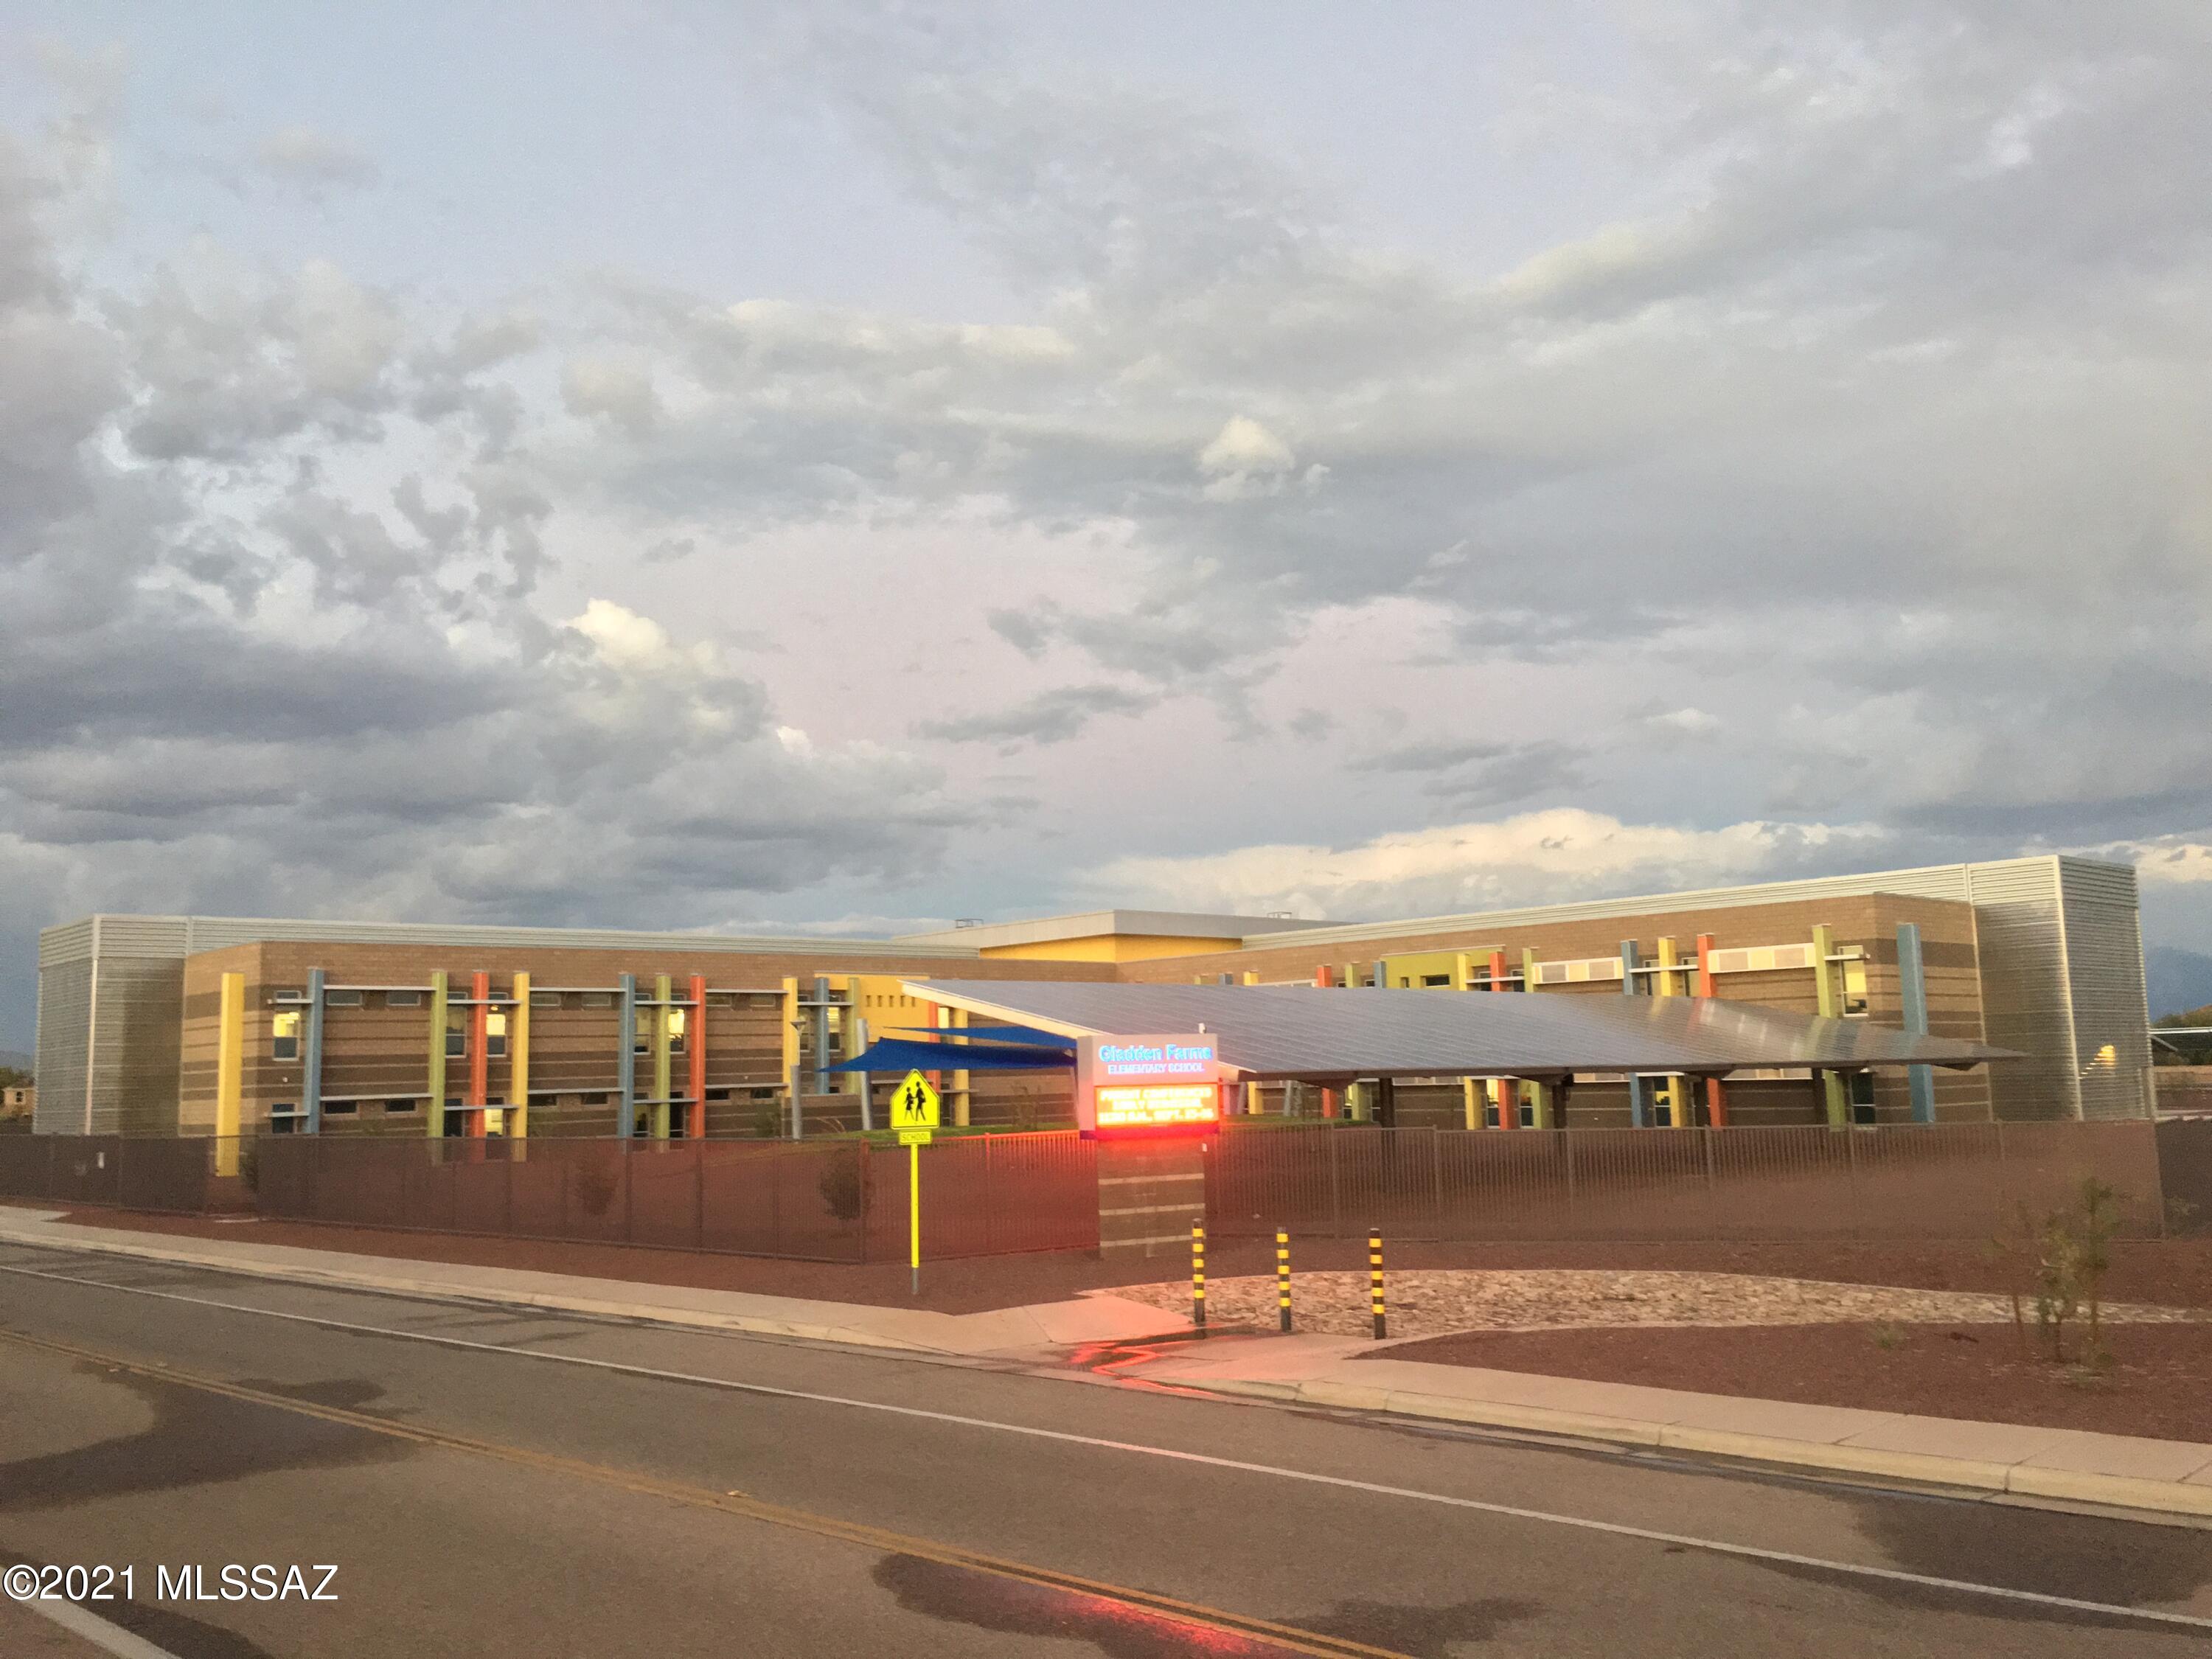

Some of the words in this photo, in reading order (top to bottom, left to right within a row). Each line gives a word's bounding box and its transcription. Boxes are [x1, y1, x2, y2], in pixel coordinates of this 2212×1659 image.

[1099, 1045, 1163, 1062] Gladden
[1166, 1044, 1213, 1060] Farms
[1108, 1063, 1166, 1074] ELEMENTARY
[1168, 1062, 1205, 1073] SCHOOL
[901, 1133, 931, 1141] SCHOOL
